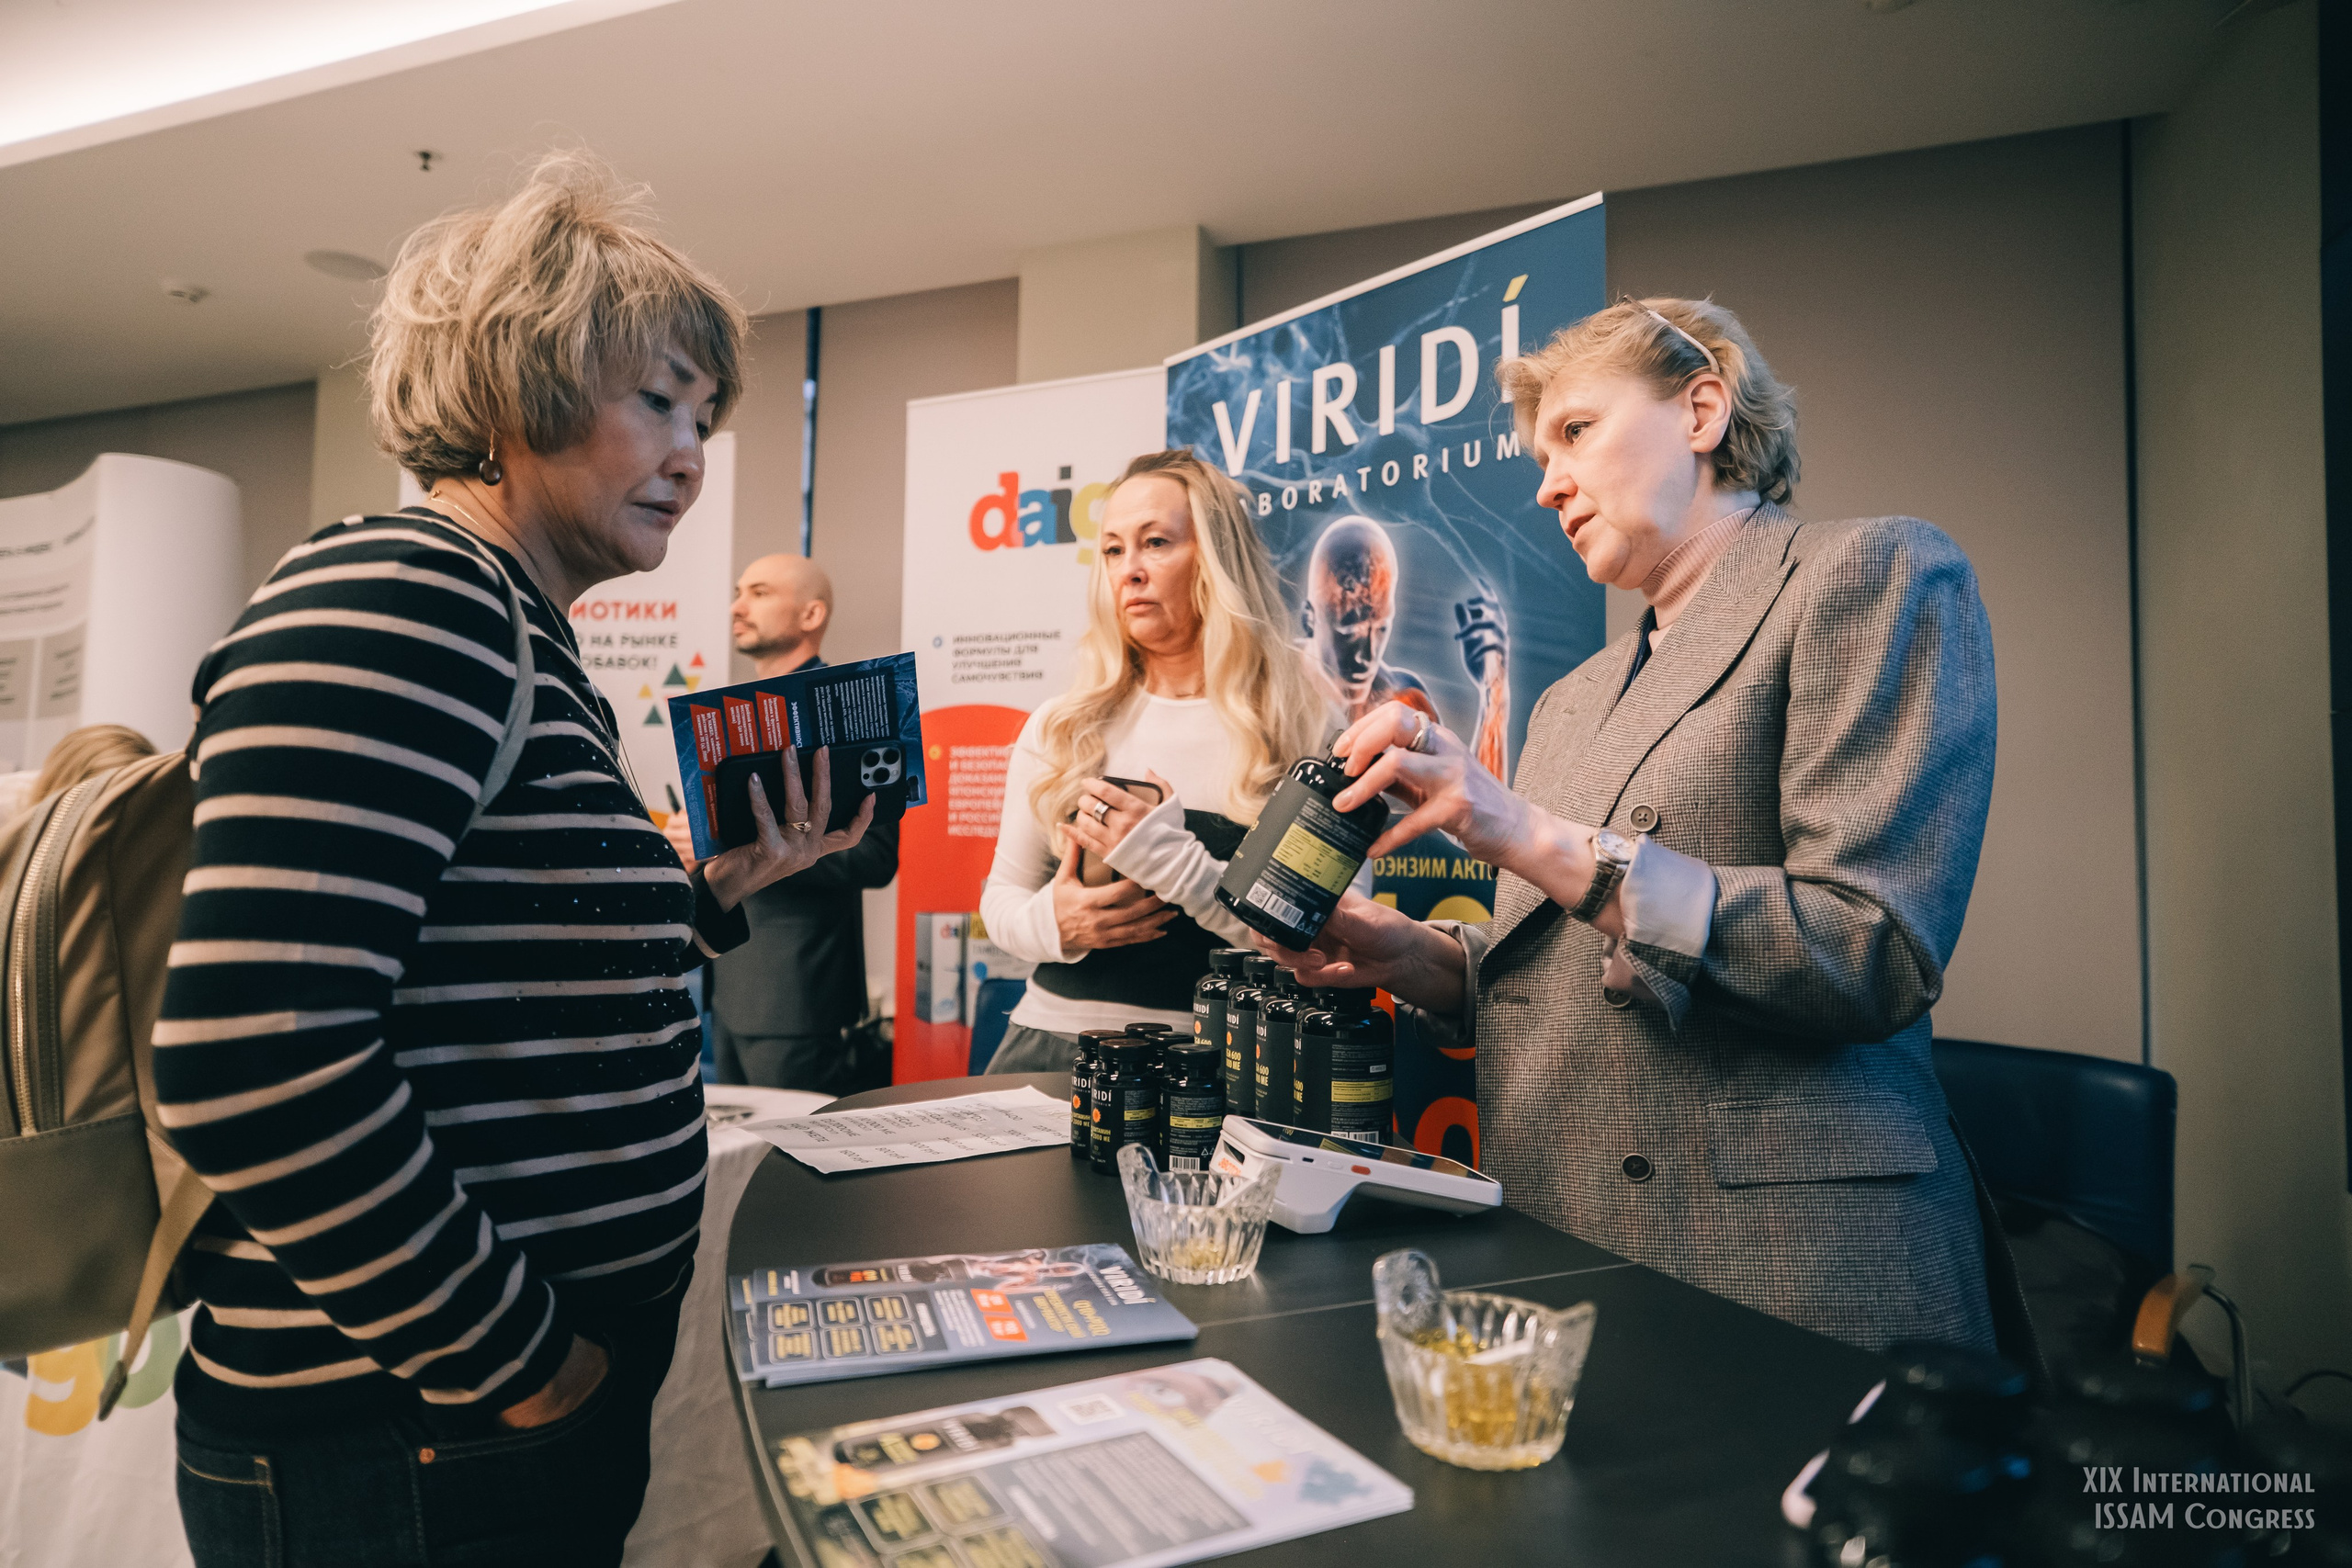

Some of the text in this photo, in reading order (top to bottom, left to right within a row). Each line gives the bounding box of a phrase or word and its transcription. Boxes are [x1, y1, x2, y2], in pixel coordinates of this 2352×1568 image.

[1212, 273, 1529, 478] VIRIDÍ
[1240, 430, 1521, 516] BORATORIUM
[968, 465, 1111, 565] daig
[571, 602, 677, 621] ИОТИКИ
[582, 656, 657, 670] ОБАВОК!
[791, 701, 803, 748] ЭФФЕКТИВНОСТ
[1374, 856, 1446, 878] ОЭНЗИМ
[1071, 1076, 1091, 1089] IRIDÍ
